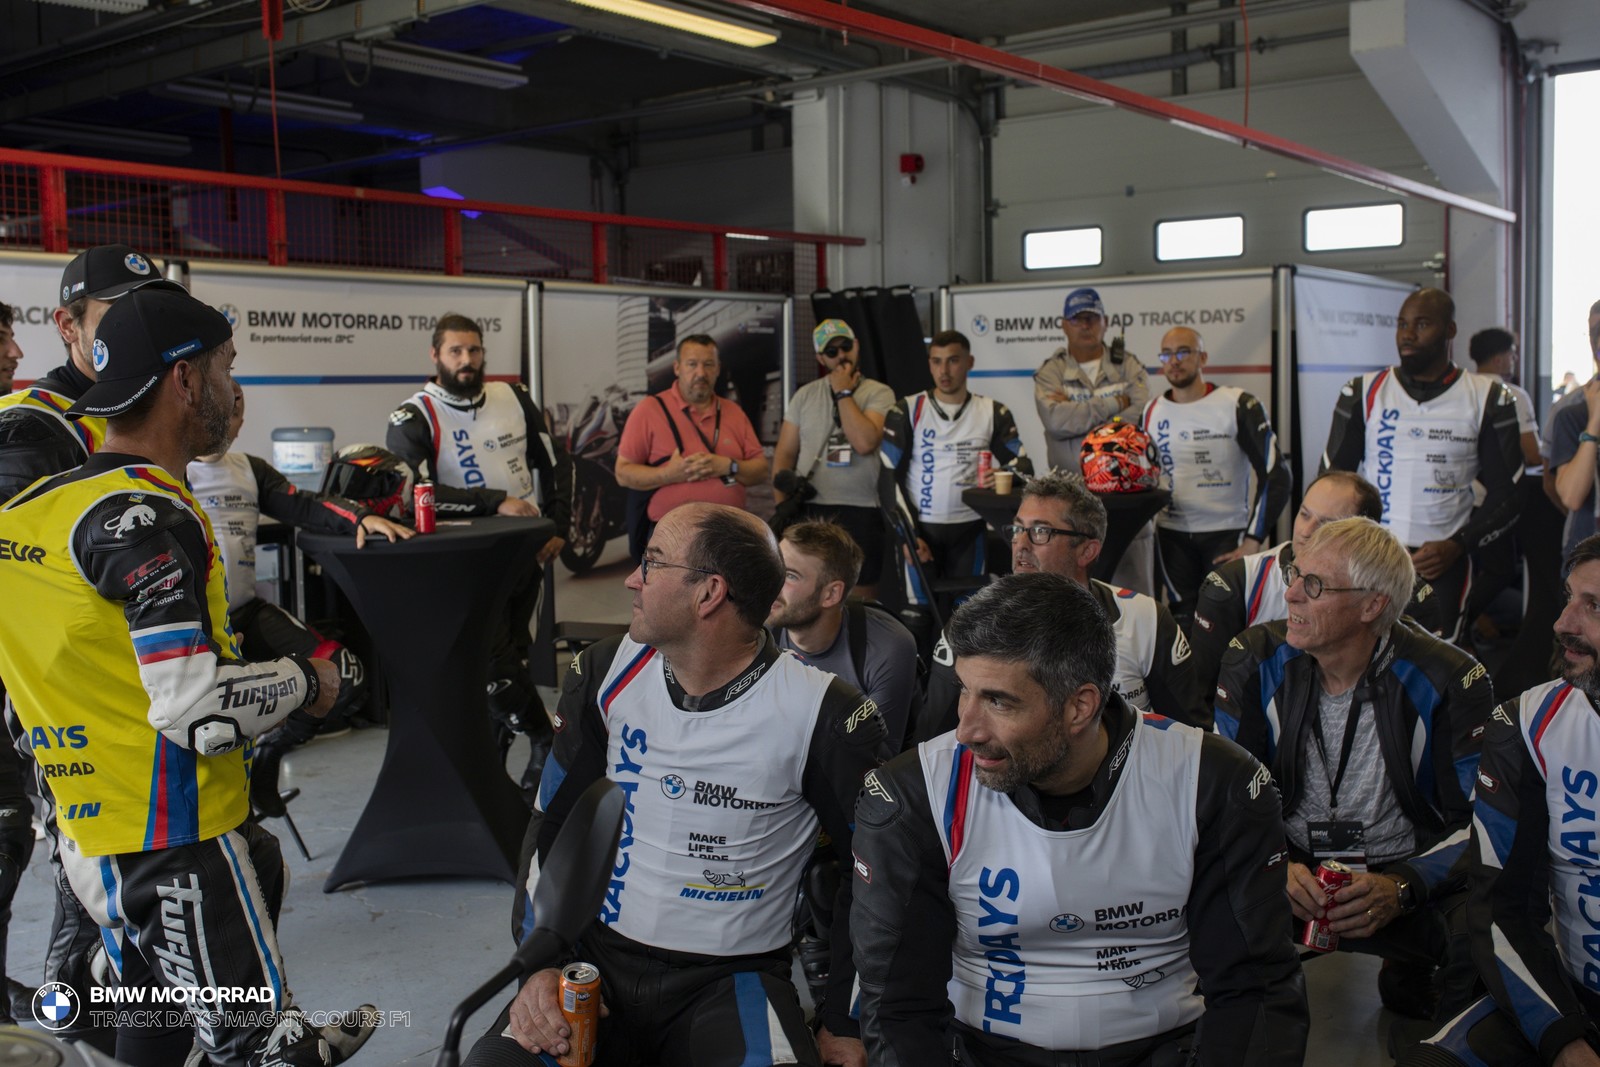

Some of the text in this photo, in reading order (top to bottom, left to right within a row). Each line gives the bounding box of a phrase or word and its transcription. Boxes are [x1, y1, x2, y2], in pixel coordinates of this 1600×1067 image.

[12, 306, 57, 325] ACK
[248, 311, 502, 333] BMW MOTORRAD TRA AYS
[994, 308, 1246, 332] BMW MOAD TRACK DAYS
[250, 333, 261, 342] En
[263, 333, 312, 344] partenariat
[313, 336, 332, 344] avec
[100, 398, 133, 412] MOTORRAD
[131, 385, 148, 401] TRACK
[453, 429, 487, 490] DAYS
[123, 550, 174, 587] TCX
[725, 663, 766, 701] RST
[216, 671, 299, 717] Furygan
[694, 780, 738, 799] BMW
[688, 842, 714, 853] LIFE
[689, 832, 727, 845] MAKE
[679, 887, 765, 902] MICHELIN
[1094, 901, 1144, 923] BMW
[1096, 945, 1137, 960] MAKE
